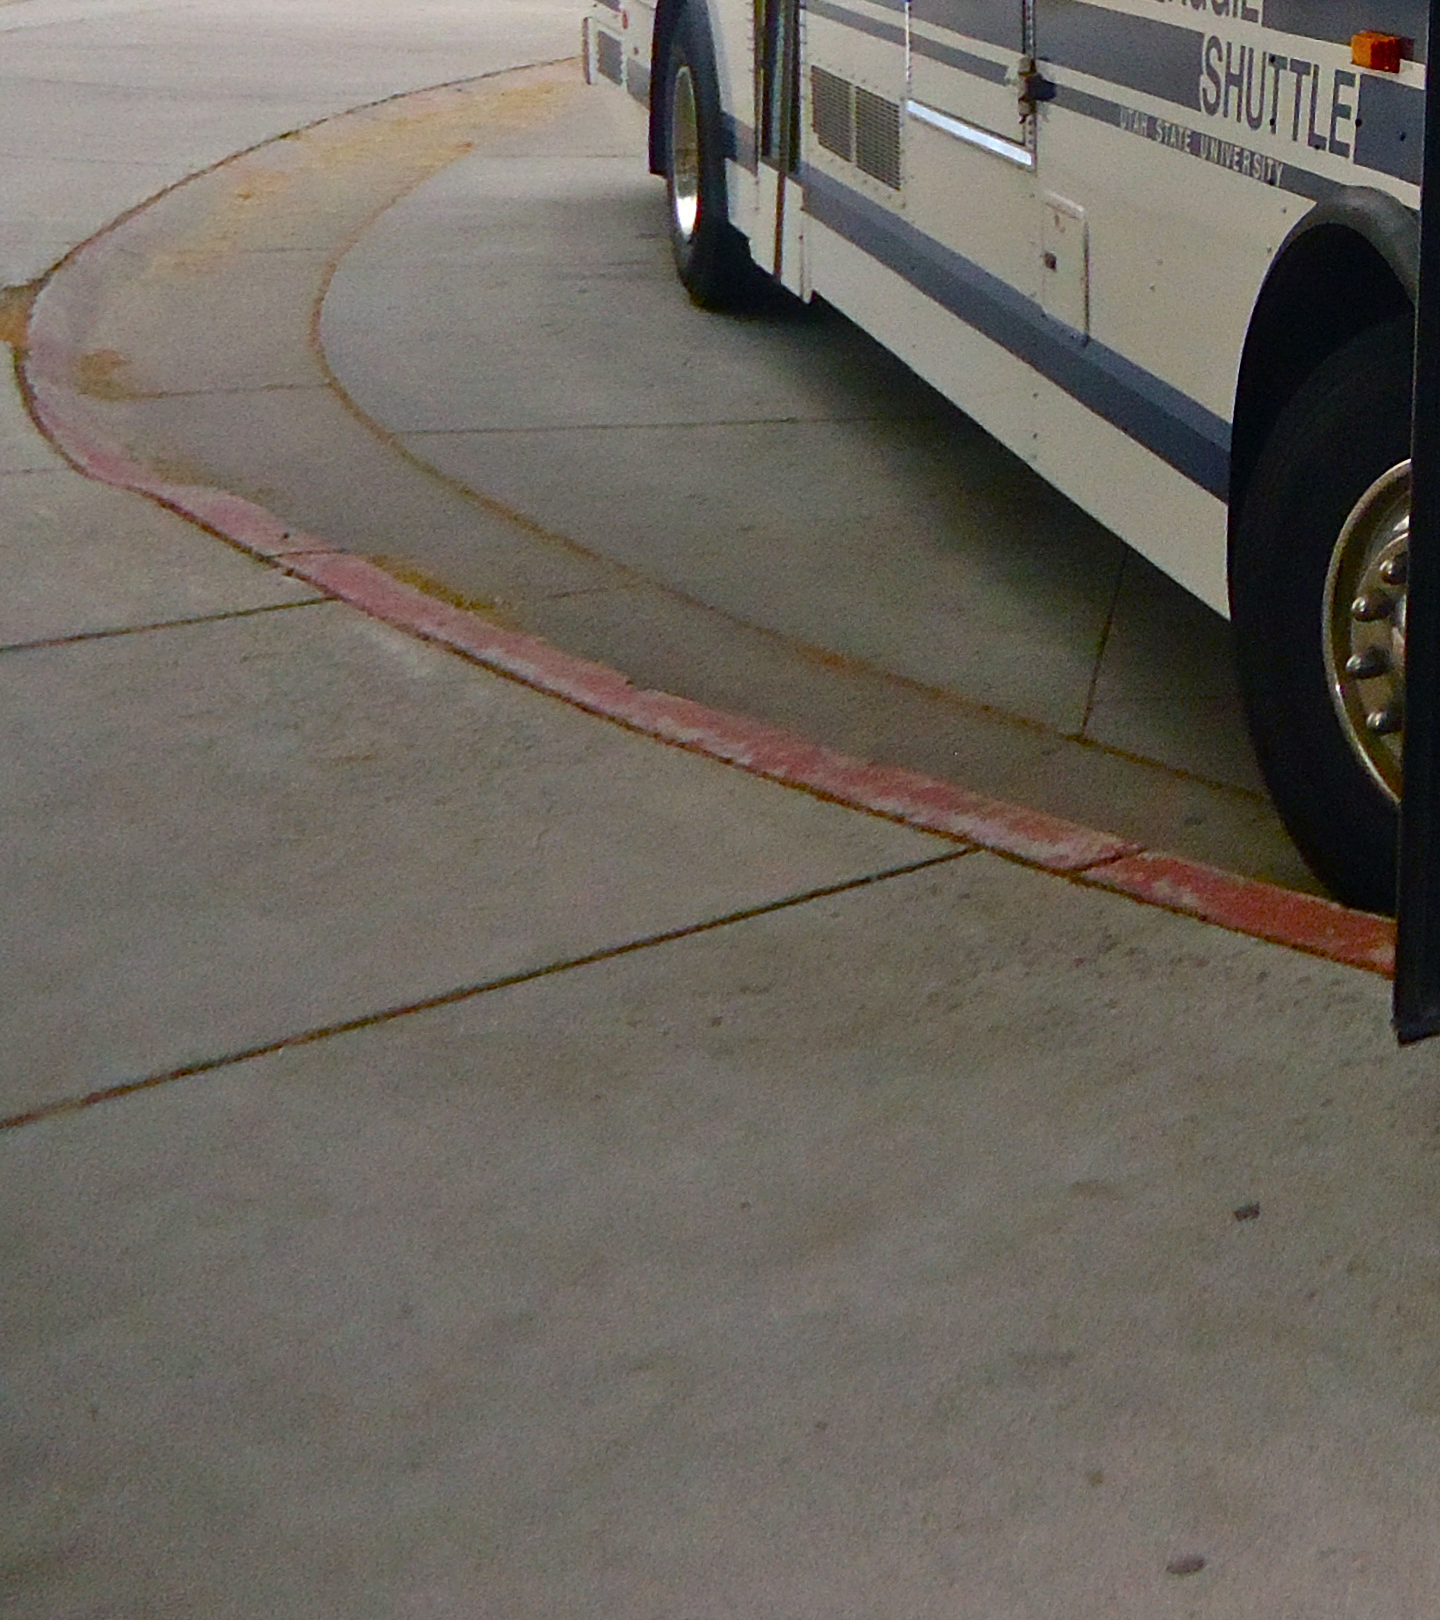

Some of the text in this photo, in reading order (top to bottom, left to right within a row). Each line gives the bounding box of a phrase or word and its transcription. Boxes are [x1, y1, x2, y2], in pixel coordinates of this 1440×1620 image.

[1118, 106, 1284, 187] UTAH STATE UNIVERSITY
[1201, 35, 1357, 159] SHUTTLE
